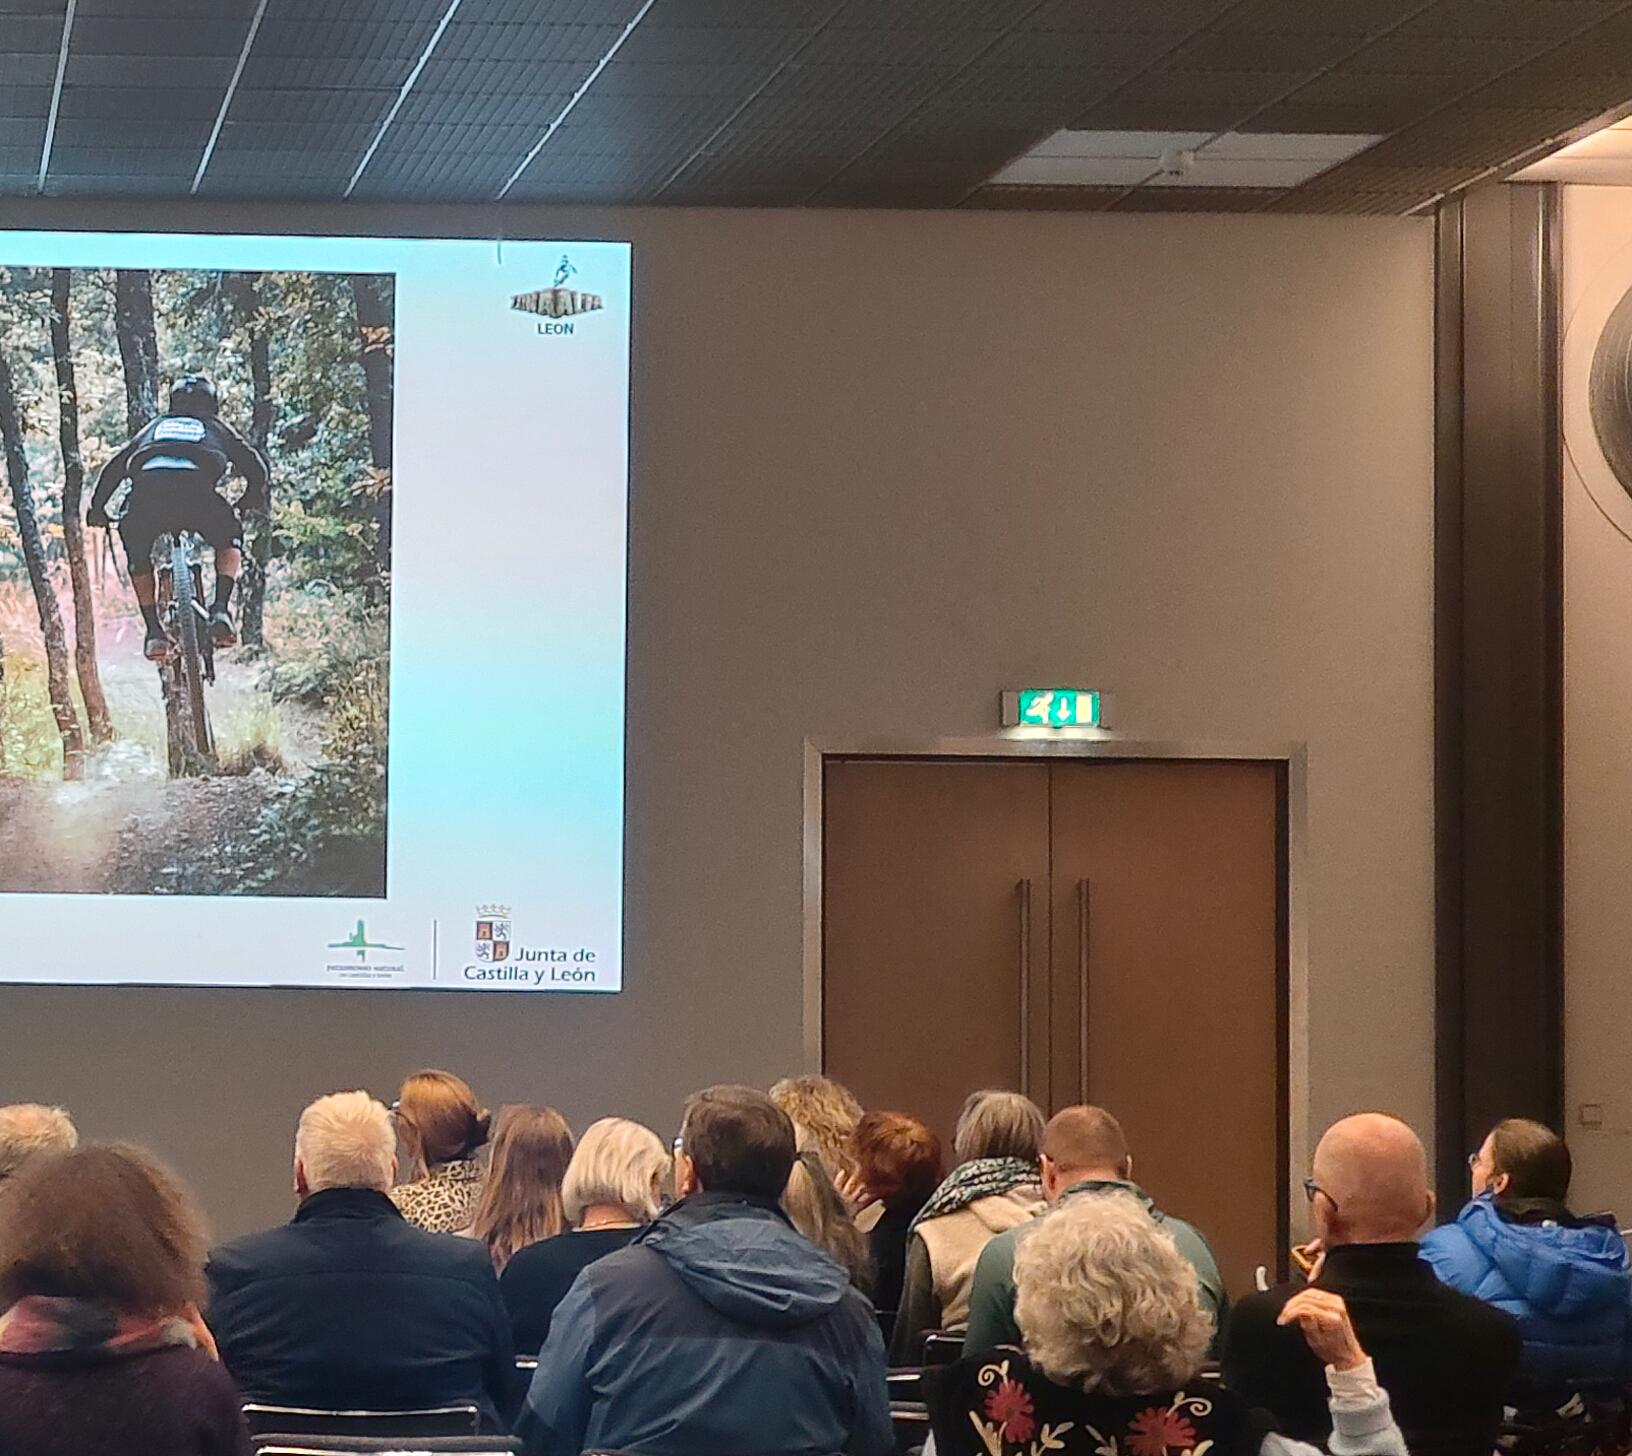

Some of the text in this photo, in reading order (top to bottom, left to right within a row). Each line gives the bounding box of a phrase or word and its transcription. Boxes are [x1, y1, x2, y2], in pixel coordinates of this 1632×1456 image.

[537, 323, 574, 335] LEON
[514, 947, 596, 962] Junta de
[464, 966, 596, 985] Castilla y León
